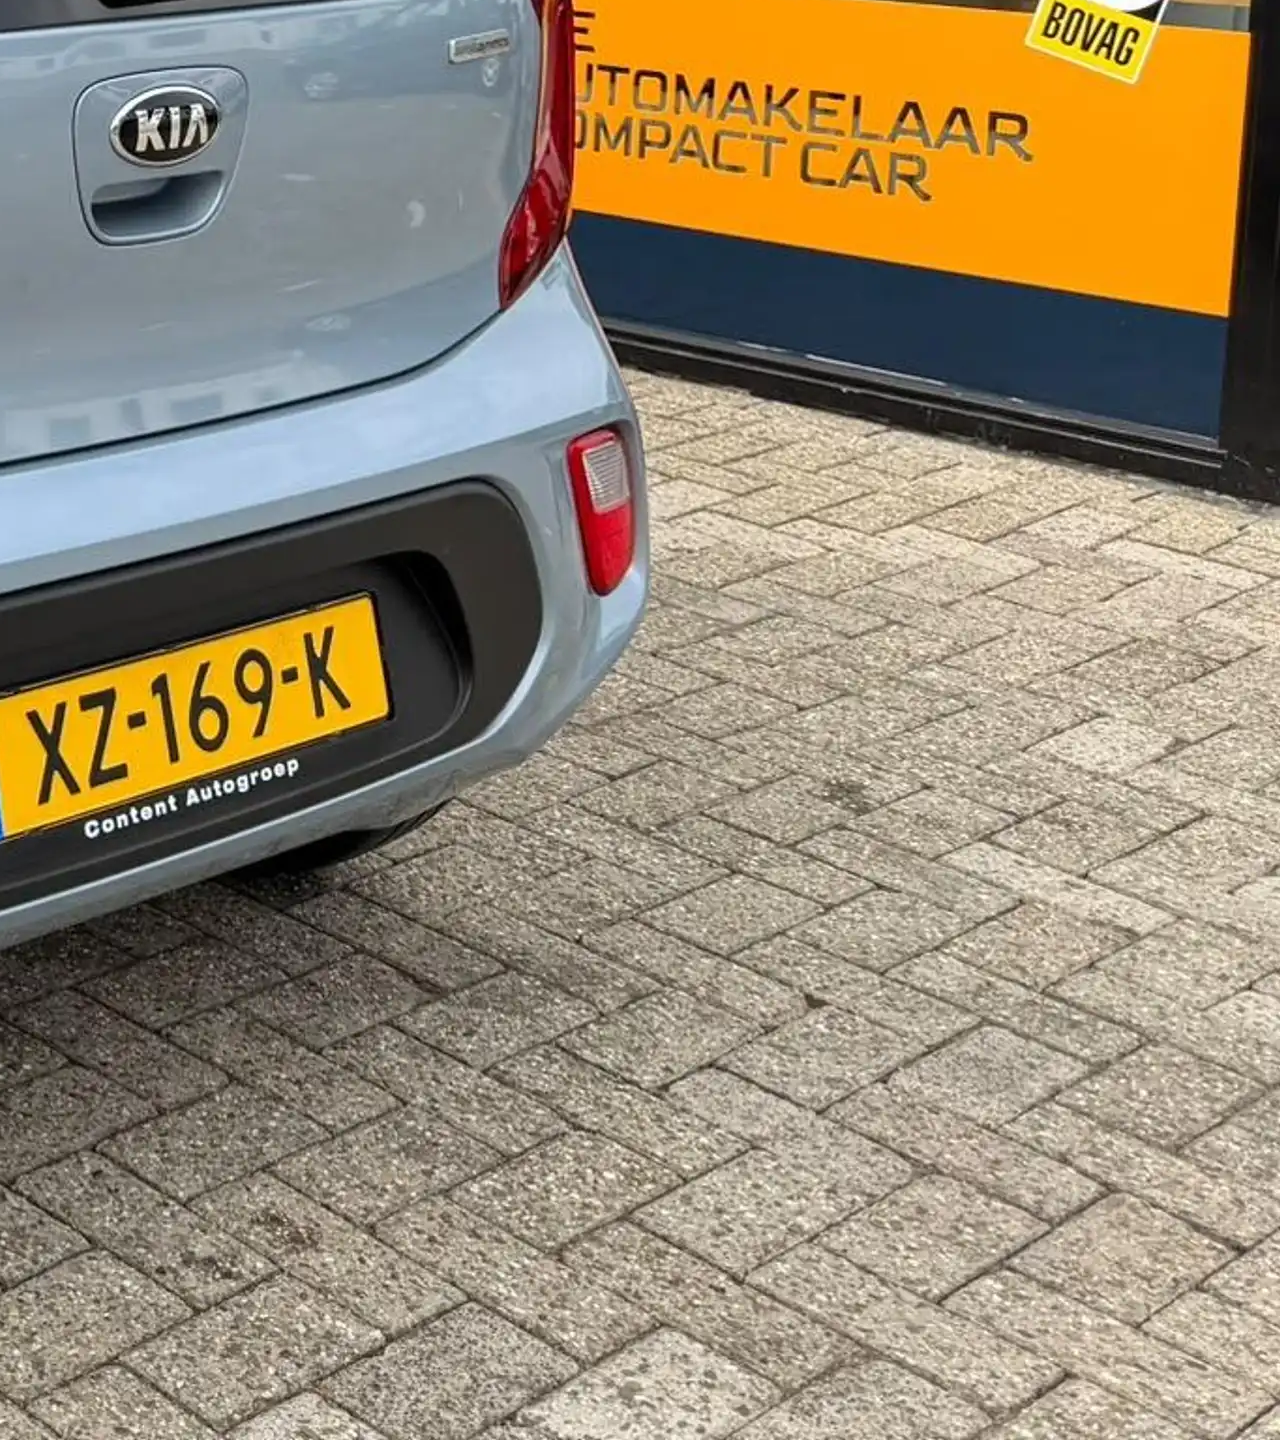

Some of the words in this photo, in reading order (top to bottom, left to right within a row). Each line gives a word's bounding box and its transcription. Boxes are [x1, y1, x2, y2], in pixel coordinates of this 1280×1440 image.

[1041, 0, 1141, 66] BOVAG
[134, 102, 209, 153] KIA
[574, 62, 1034, 162] UTOMAKELAAR
[574, 111, 788, 179] MPACT
[799, 141, 932, 202] CAR
[26, 625, 352, 806] XZ-169-K
[83, 794, 179, 839] Content
[185, 758, 301, 807] Autogroep
